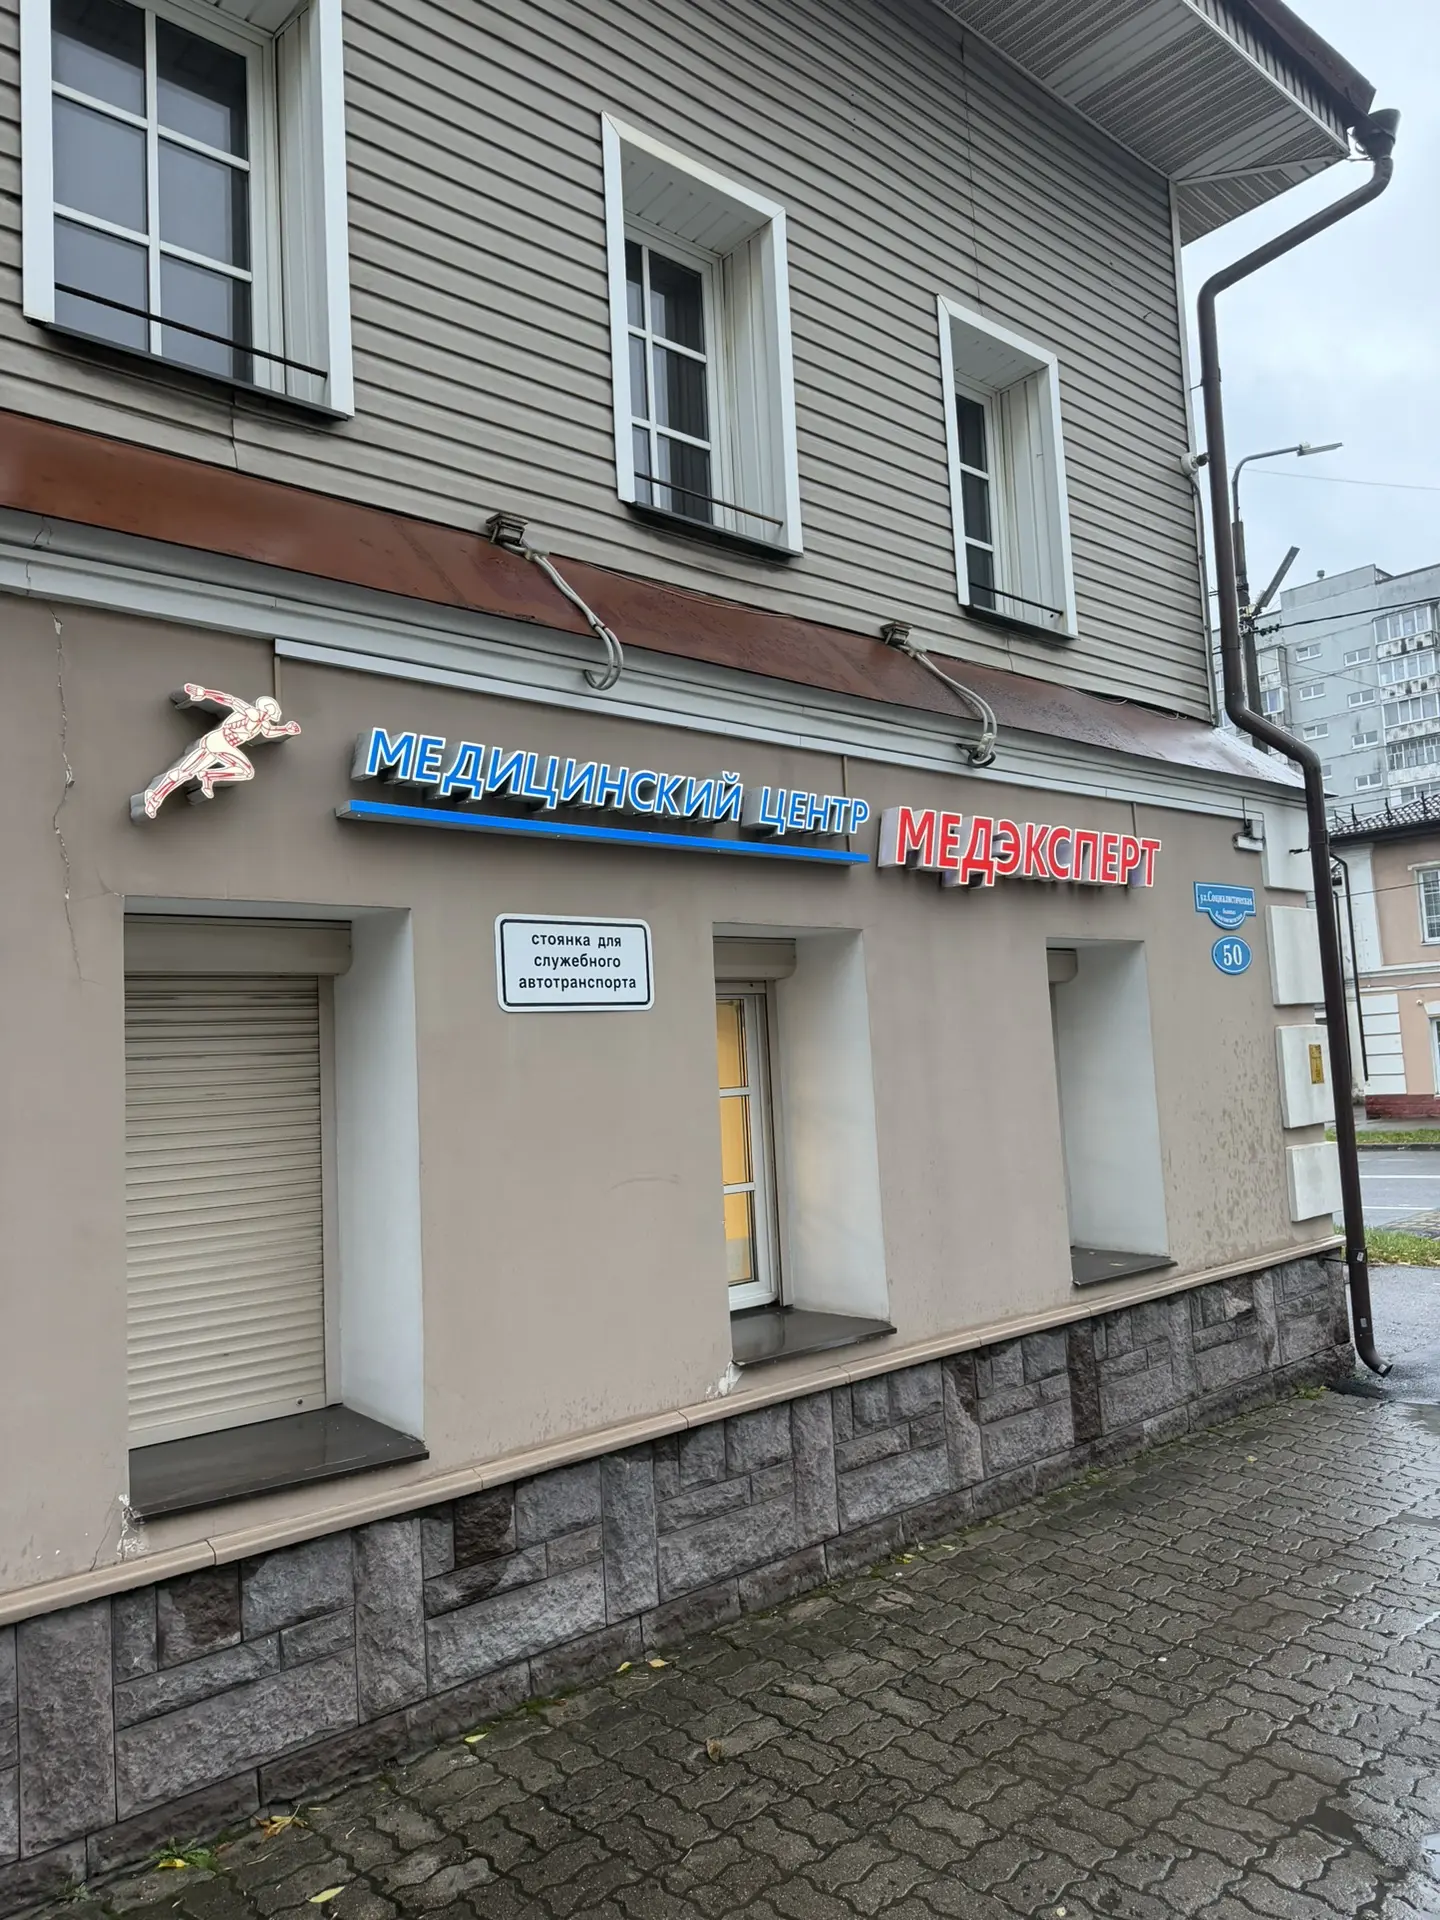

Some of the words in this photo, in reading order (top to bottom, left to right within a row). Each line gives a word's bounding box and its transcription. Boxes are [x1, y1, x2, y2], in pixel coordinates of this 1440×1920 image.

[365, 727, 743, 822] МЕДИЦИНСКИЙ
[759, 786, 869, 835] ЦЕНТР
[895, 806, 1161, 888] МЕДЭКСПЕРТ
[531, 934, 591, 946] стоянка
[598, 937, 622, 949] для
[534, 953, 621, 970] служебного
[1223, 943, 1243, 966] 50
[519, 977, 636, 991] автотранспорта
